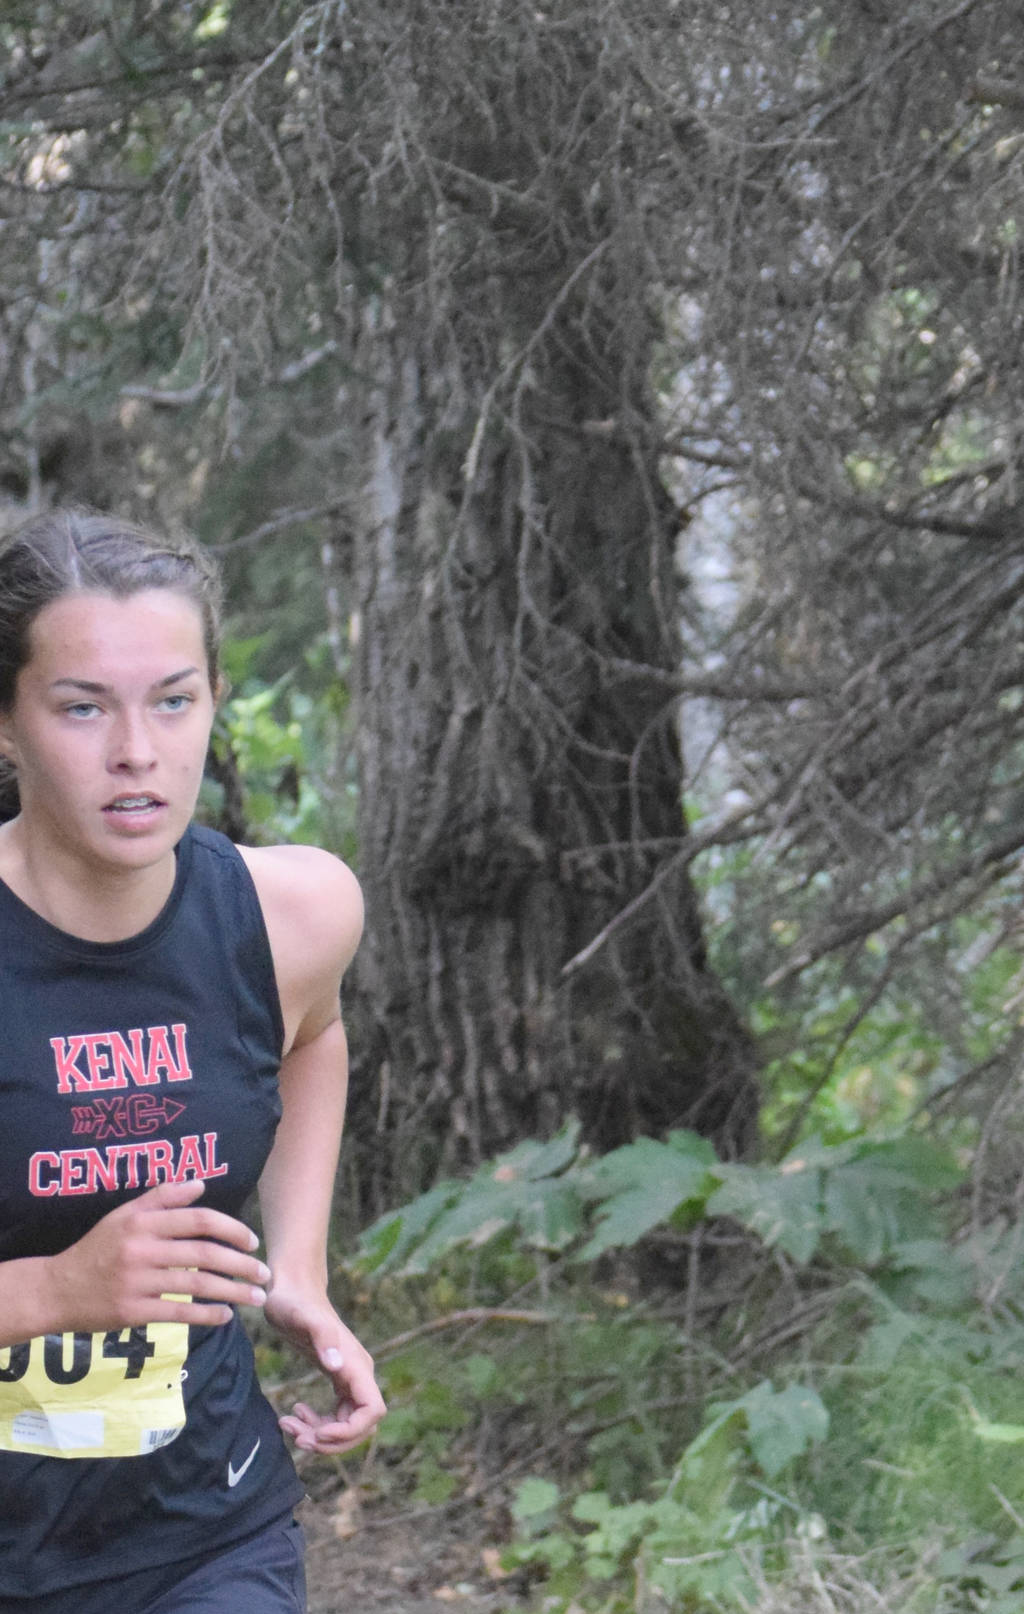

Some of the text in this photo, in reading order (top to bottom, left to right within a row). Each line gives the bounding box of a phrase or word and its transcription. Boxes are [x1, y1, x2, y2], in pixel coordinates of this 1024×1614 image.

[50, 1024, 192, 1094] KENAI
[93, 1093, 158, 1139] XC
[28, 1132, 228, 1197] CENTRAL
